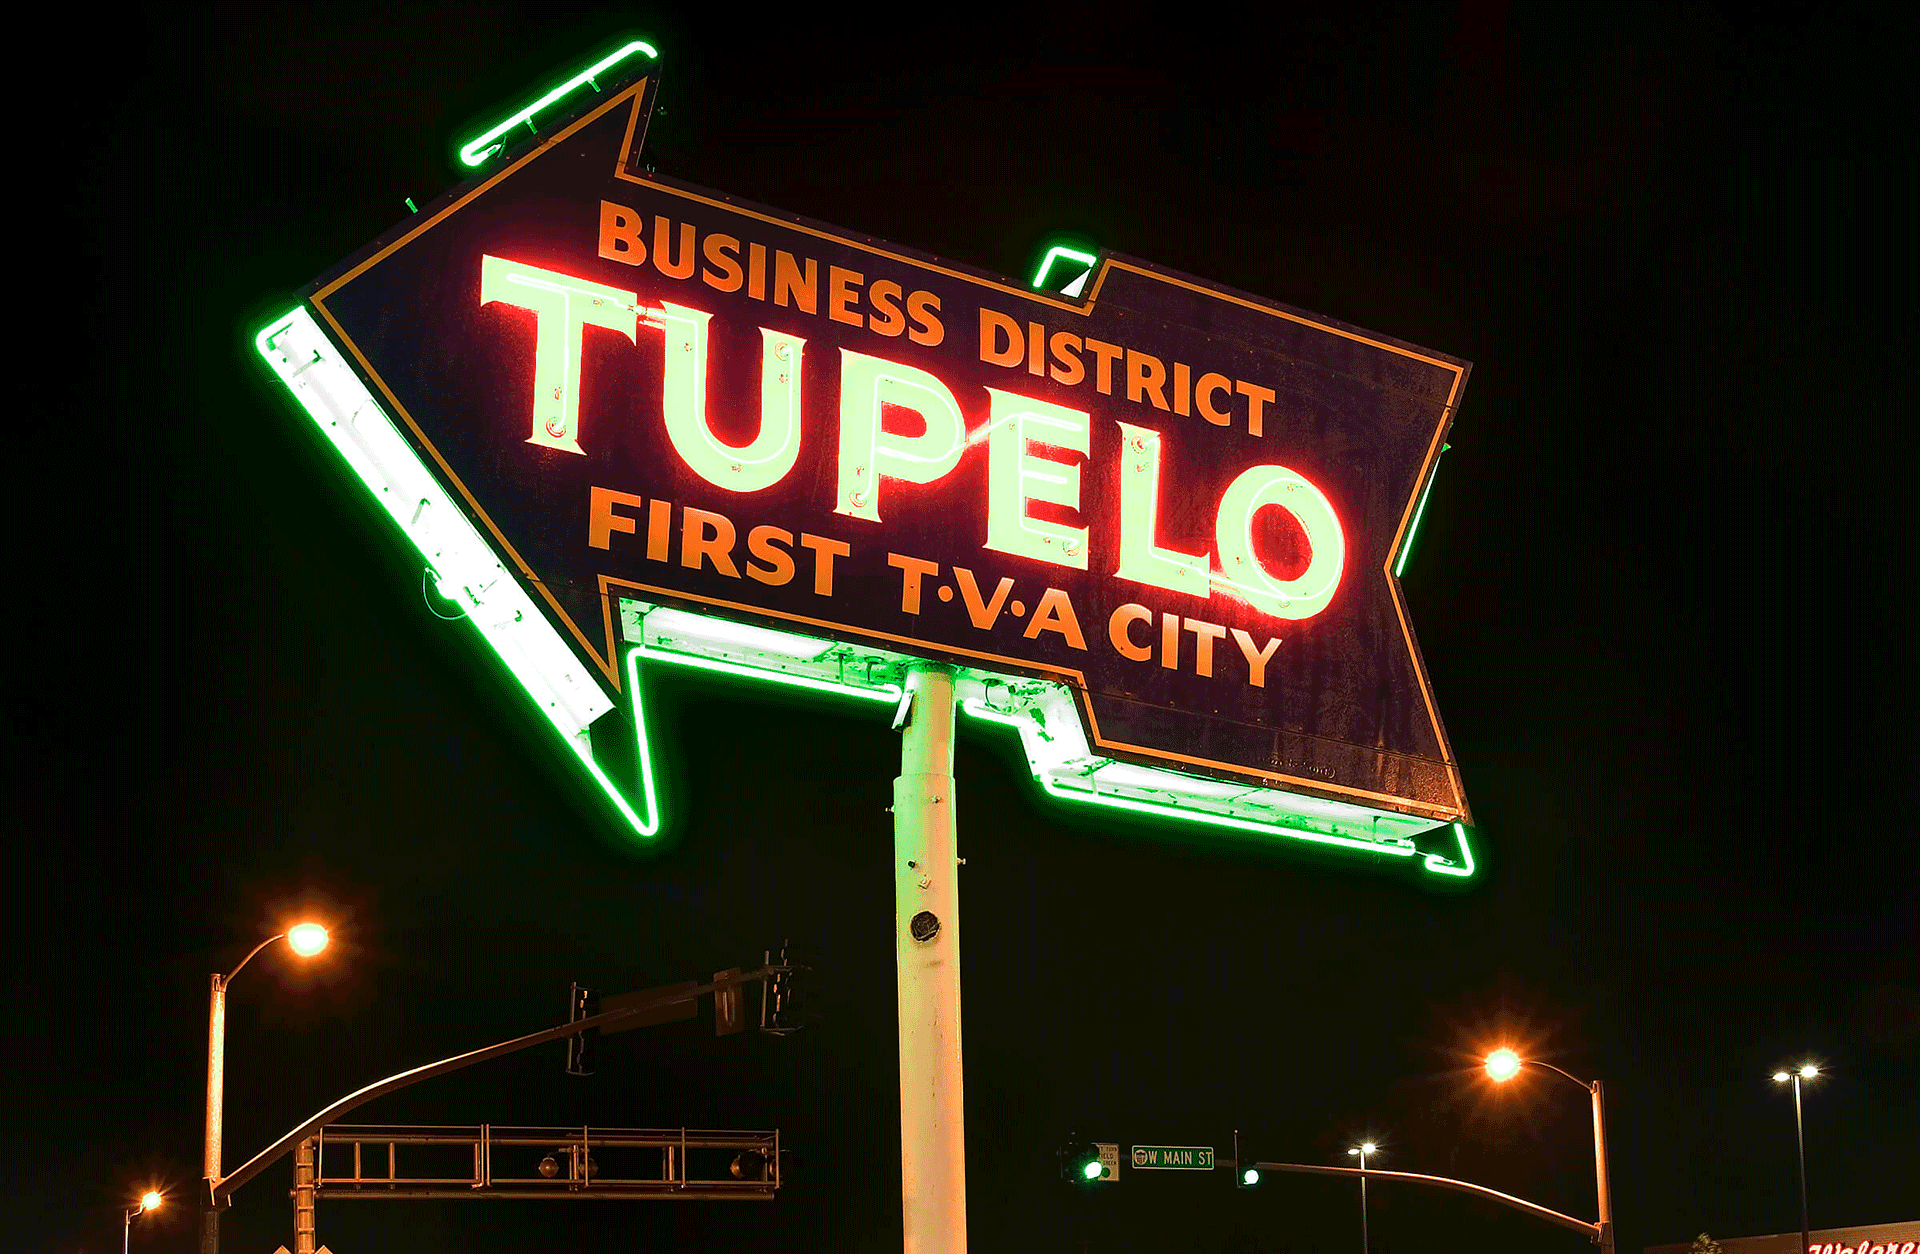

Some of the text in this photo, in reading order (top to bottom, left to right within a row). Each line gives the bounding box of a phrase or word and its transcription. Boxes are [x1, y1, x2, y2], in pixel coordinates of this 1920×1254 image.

[597, 198, 1276, 437] BUSINESS DISTRICT
[481, 254, 1345, 621] TUPELO
[588, 486, 850, 597] FIRST
[1108, 602, 1283, 689] CITY
[1148, 1150, 1213, 1166] W MAIN ST
